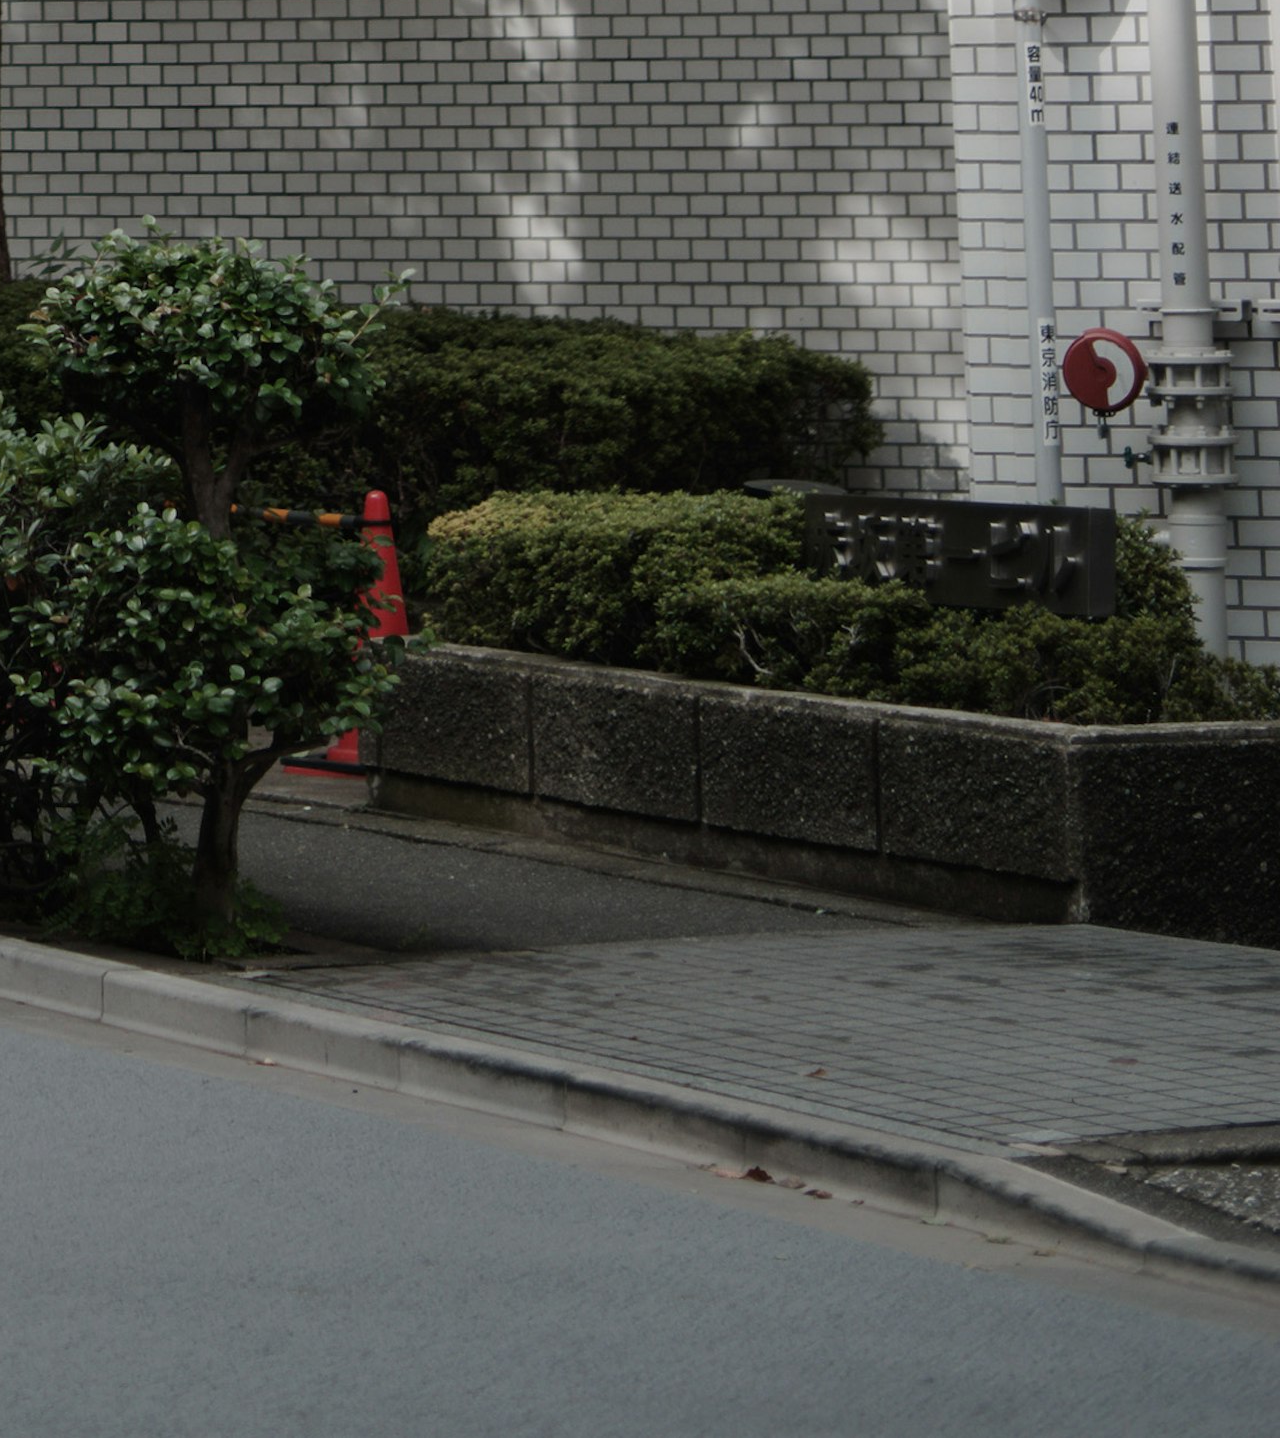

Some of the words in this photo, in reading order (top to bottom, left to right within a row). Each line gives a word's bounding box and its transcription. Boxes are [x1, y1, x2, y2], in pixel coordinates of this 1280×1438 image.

[1166, 121, 1186, 286] 連結送水配管
[1040, 324, 1059, 440] 東京消防庁
